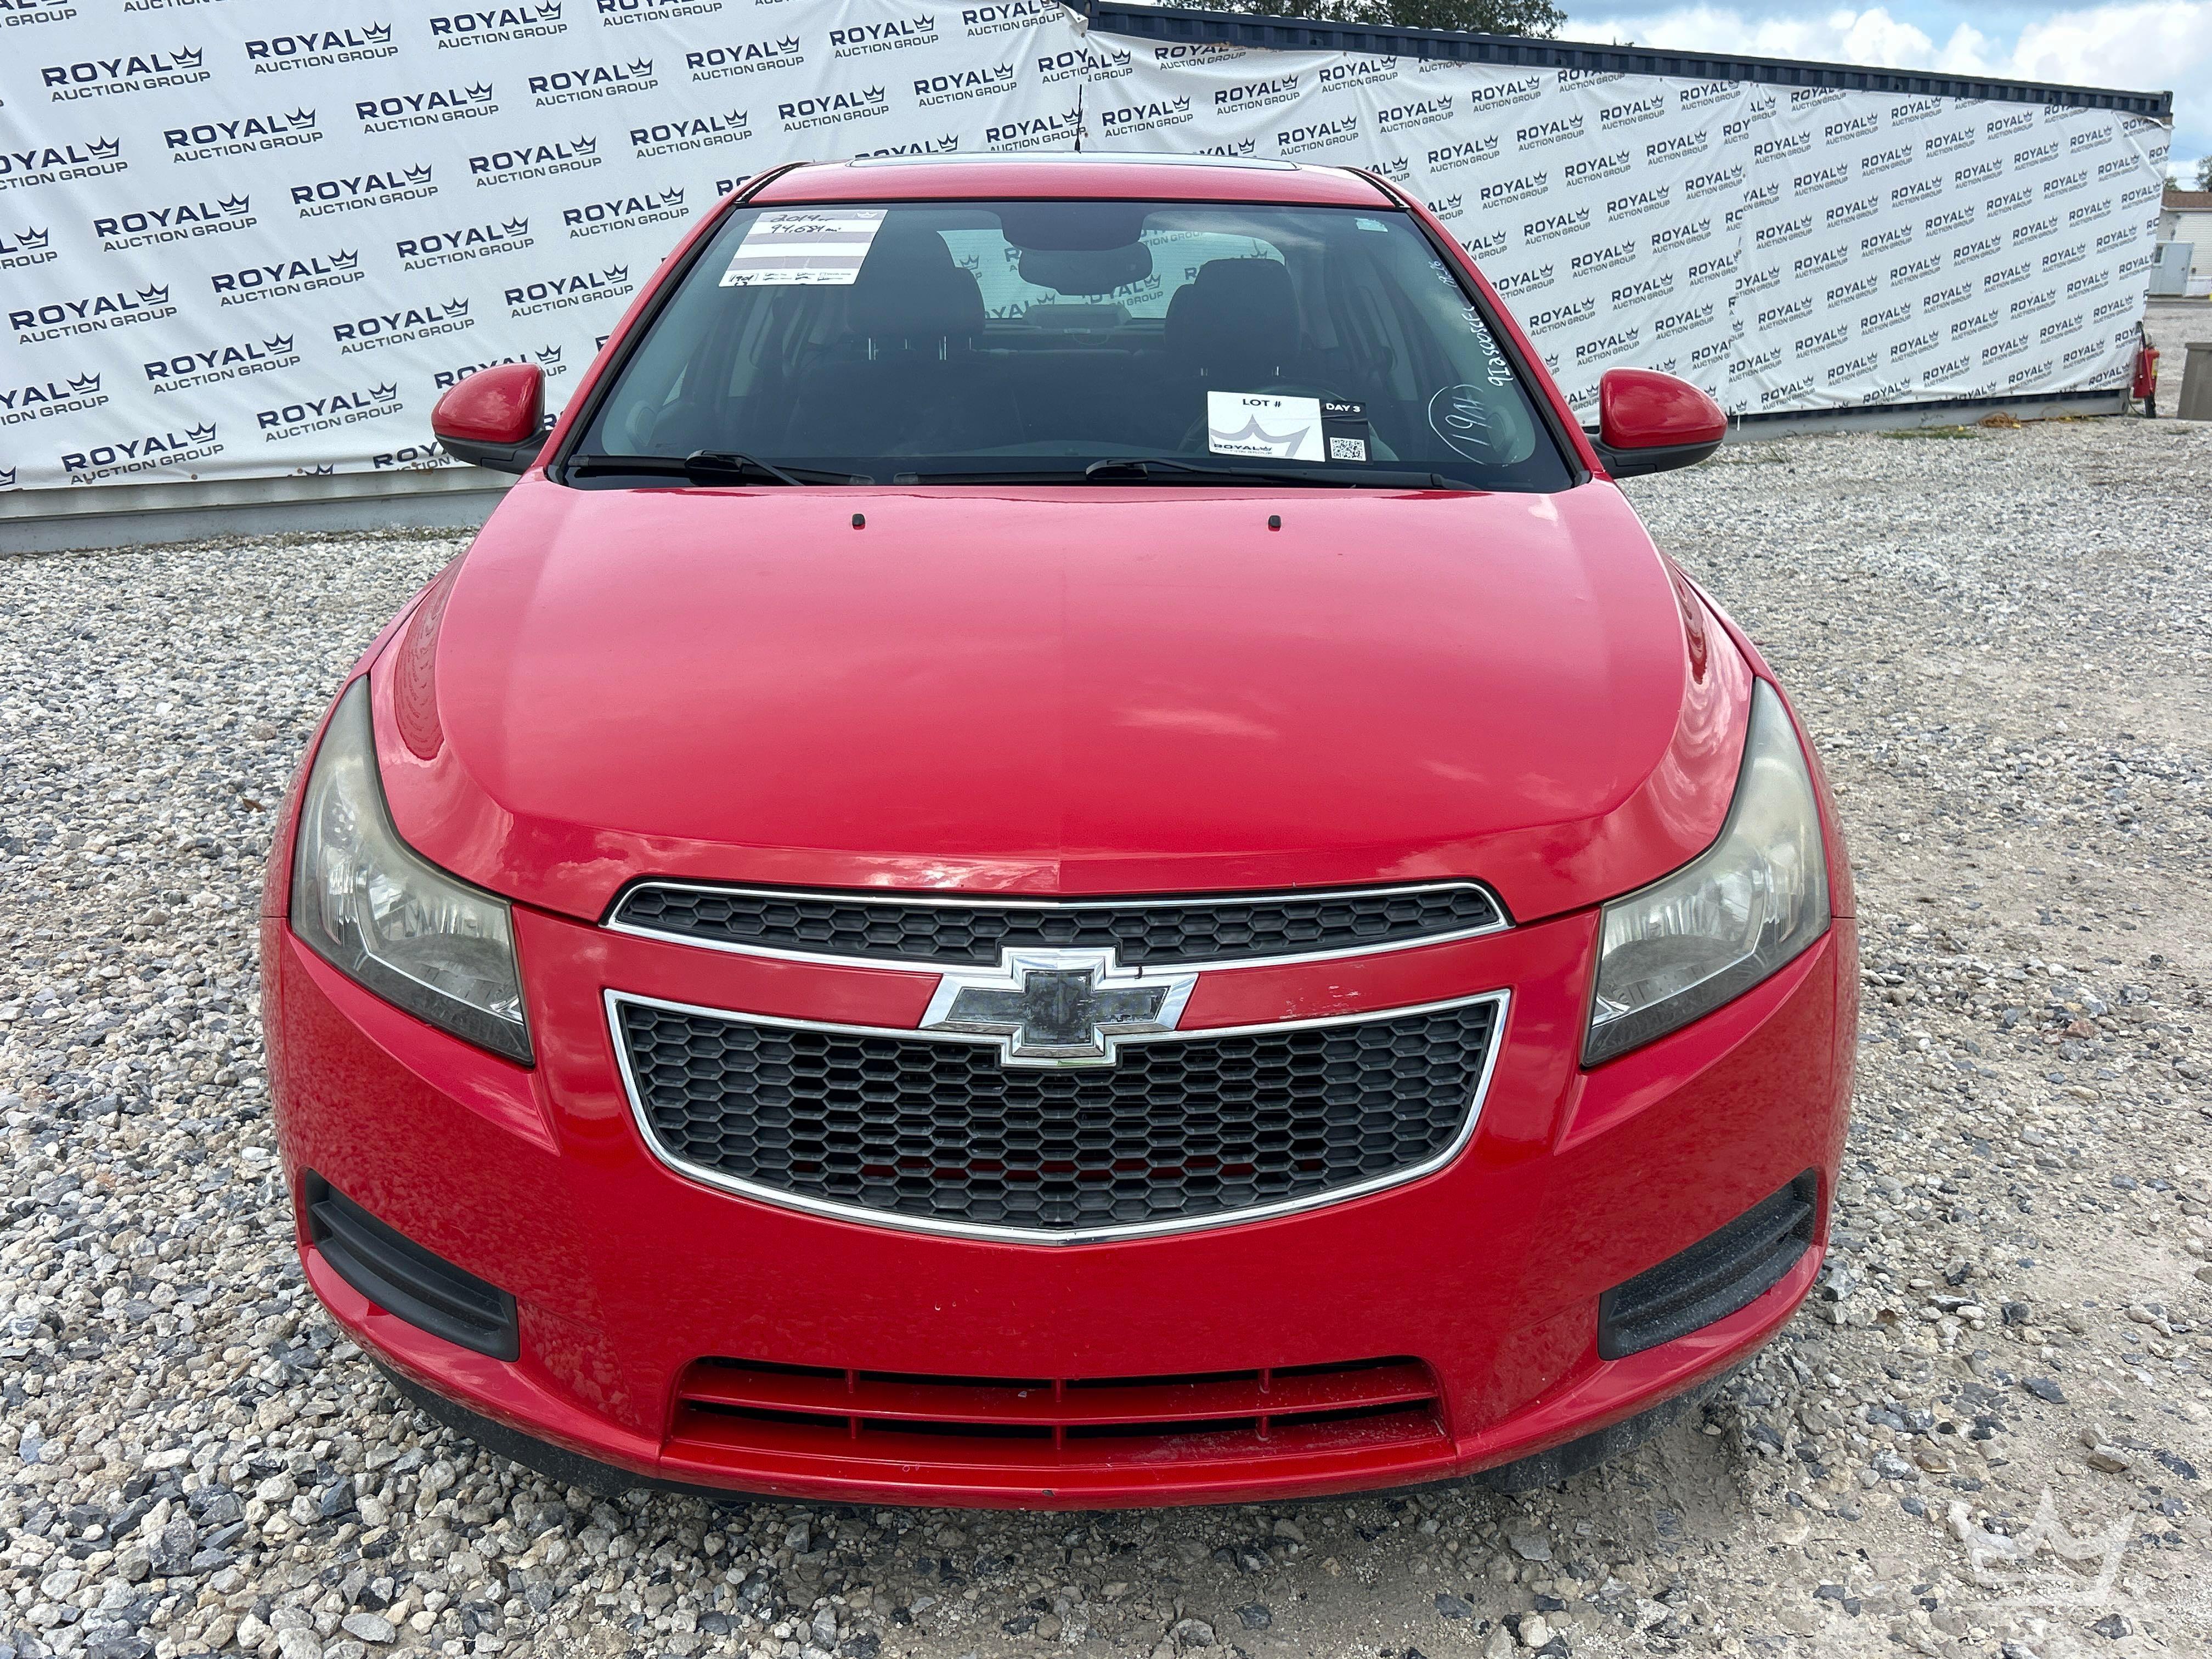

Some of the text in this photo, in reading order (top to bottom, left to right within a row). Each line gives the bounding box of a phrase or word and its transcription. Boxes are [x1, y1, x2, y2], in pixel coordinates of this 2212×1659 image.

[5, 9, 77, 26] GROUP
[430, 8, 538, 35] ROYAL
[603, 10, 669, 26] AUCTION
[672, 3, 722, 16] GROUP
[962, 0, 1040, 25] ROYAL
[968, 12, 1064, 36] AUCTION GROUP
[245, 30, 365, 59] ROYAL
[438, 24, 567, 49] AUCTION GROUP
[830, 21, 915, 46] ROYAL
[686, 42, 778, 69] ROYAL
[835, 35, 938, 58] AUCTION GROUP
[41, 54, 173, 87] ROYAL
[255, 47, 398, 74] AUCTION GROUP
[692, 57, 804, 82] AUCTION GROUP
[1160, 52, 1246, 70] AUCTION GROUP
[1319, 60, 1380, 83] ROYAL
[52, 71, 211, 102] AUCTION GROUP
[528, 65, 629, 93] ROYAL
[914, 69, 994, 95] ROYAL
[1094, 68, 1133, 81] GROUP
[1322, 72, 1398, 93] AUCTION GROUP
[356, 89, 467, 120] ROYAL
[535, 80, 658, 106] AUCTION GROUP
[919, 82, 1017, 107] AUCTION GROUP
[1215, 80, 1281, 104] ROYAL
[1217, 92, 1299, 115] AUCTION GROUP
[778, 92, 864, 120] ROYAL
[785, 105, 889, 132] AUCTION GROUP
[1102, 102, 1173, 126] ROYAL
[1378, 101, 1437, 123] ROYAL
[163, 116, 288, 148] ROYAL
[364, 105, 498, 134] AUCTION GROUP
[630, 117, 725, 146] ROYAL
[985, 116, 1063, 143] ROYAL
[1105, 114, 1193, 137] AUCTION GROUP
[1380, 112, 1453, 134] AUCTION GROUP
[1516, 120, 1569, 142] ROYAL
[636, 131, 752, 158] AUCTION GROUP
[1042, 126, 1087, 144] GROUP
[1278, 122, 1341, 146] ROYAL
[1280, 133, 1358, 156] AUCTION GROUP
[1647, 136, 1694, 157] ROYAL
[174, 132, 323, 163] AUCTION GROUP
[469, 144, 573, 174] ROYAL
[1427, 140, 1484, 163] ROYAL
[1862, 149, 1901, 169] ROYAL
[59, 161, 128, 180] GROUP
[477, 157, 601, 187] AUCTION GROUP
[1431, 151, 1499, 173] AUCTION GROUP
[1565, 156, 1616, 178] ROYAL
[291, 172, 406, 204] ROYAL
[1567, 165, 1630, 187] AUCTION GROUP
[1481, 178, 1533, 200] ROYAL
[300, 187, 438, 218] AUCTION GROUP
[563, 195, 661, 226] ROYAL
[1607, 191, 1656, 213] ROYAL
[2069, 203, 2102, 221] ROYAL
[93, 203, 221, 237] ROYAL
[571, 208, 689, 239] AUCTION GROUP
[1926, 211, 1964, 229] ROYAL
[104, 217, 257, 252] AUCTION GROUP
[396, 225, 504, 258] ROYAL
[1861, 229, 1900, 250] ROYAL
[0, 251, 58, 269] ROUP
[405, 238, 534, 271] AUCTION GROUP
[1954, 239, 1990, 259] ROYAL
[2042, 247, 2076, 266] ROYAL
[211, 258, 331, 293] ROYAL
[2067, 274, 2100, 292] ROYAL
[221, 272, 364, 306] AUCTION GROUP
[505, 273, 605, 306] ROYAL
[512, 285, 633, 318] AUCTION GROUP
[9, 293, 139, 330] ROYAL
[1530, 304, 1581, 328] ROYAL
[2011, 294, 2046, 313] ROYAL
[20, 307, 177, 345] AUCTION GROUP
[333, 307, 443, 341] ROYAL
[341, 319, 474, 354] AUCTION GROUP
[1577, 334, 1626, 358] ROYAL
[2063, 345, 2096, 363] ROYAL
[144, 343, 266, 380] ROYAL
[1828, 358, 1866, 379] ROYAL
[154, 356, 300, 394] AUCTION GROUP
[0, 382, 70, 409] YAL
[41, 395, 109, 418] GROUP
[1326, 403, 1350, 411] DAY
[257, 392, 371, 429] ROYAL
[266, 404, 403, 442] AUCTION GROUP
[61, 433, 188, 472] ROYAL
[71, 444, 224, 484] AUCTION GROUP
